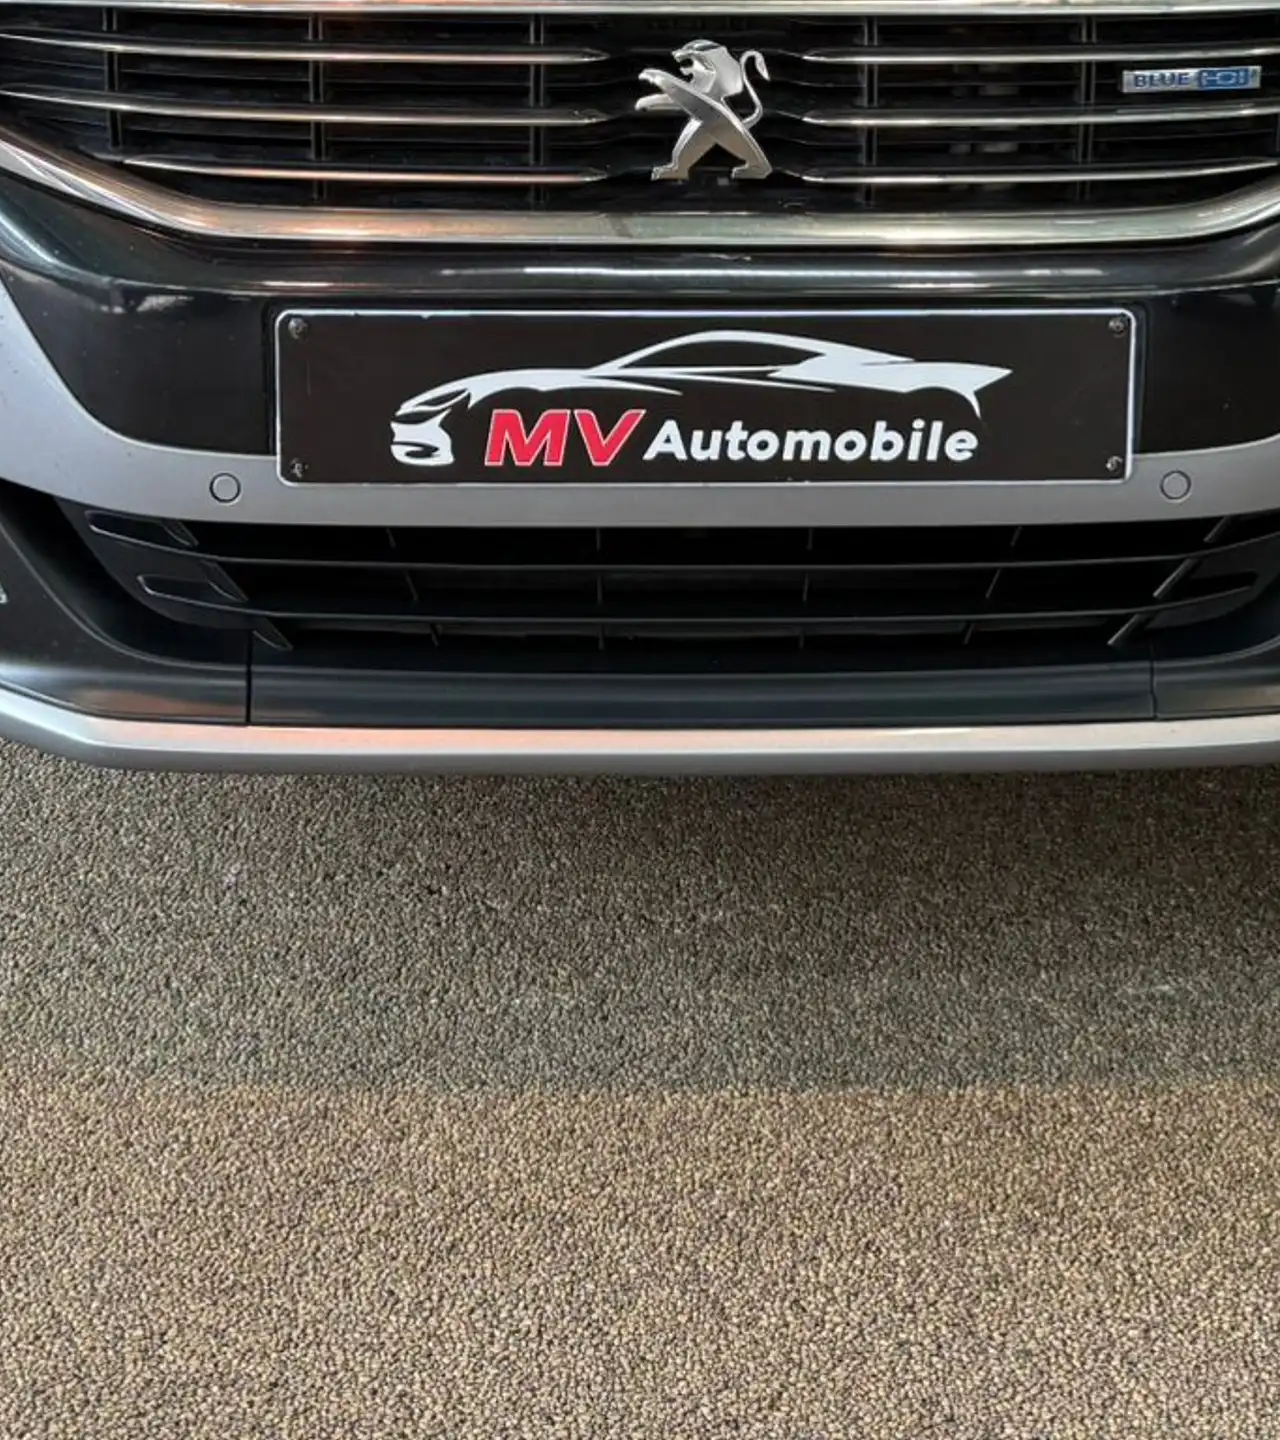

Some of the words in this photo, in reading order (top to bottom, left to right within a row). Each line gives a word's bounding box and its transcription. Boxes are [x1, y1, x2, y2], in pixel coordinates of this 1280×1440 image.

[1134, 72, 1191, 88] BLUE
[484, 409, 646, 466] MV
[643, 420, 978, 461] Automobile
